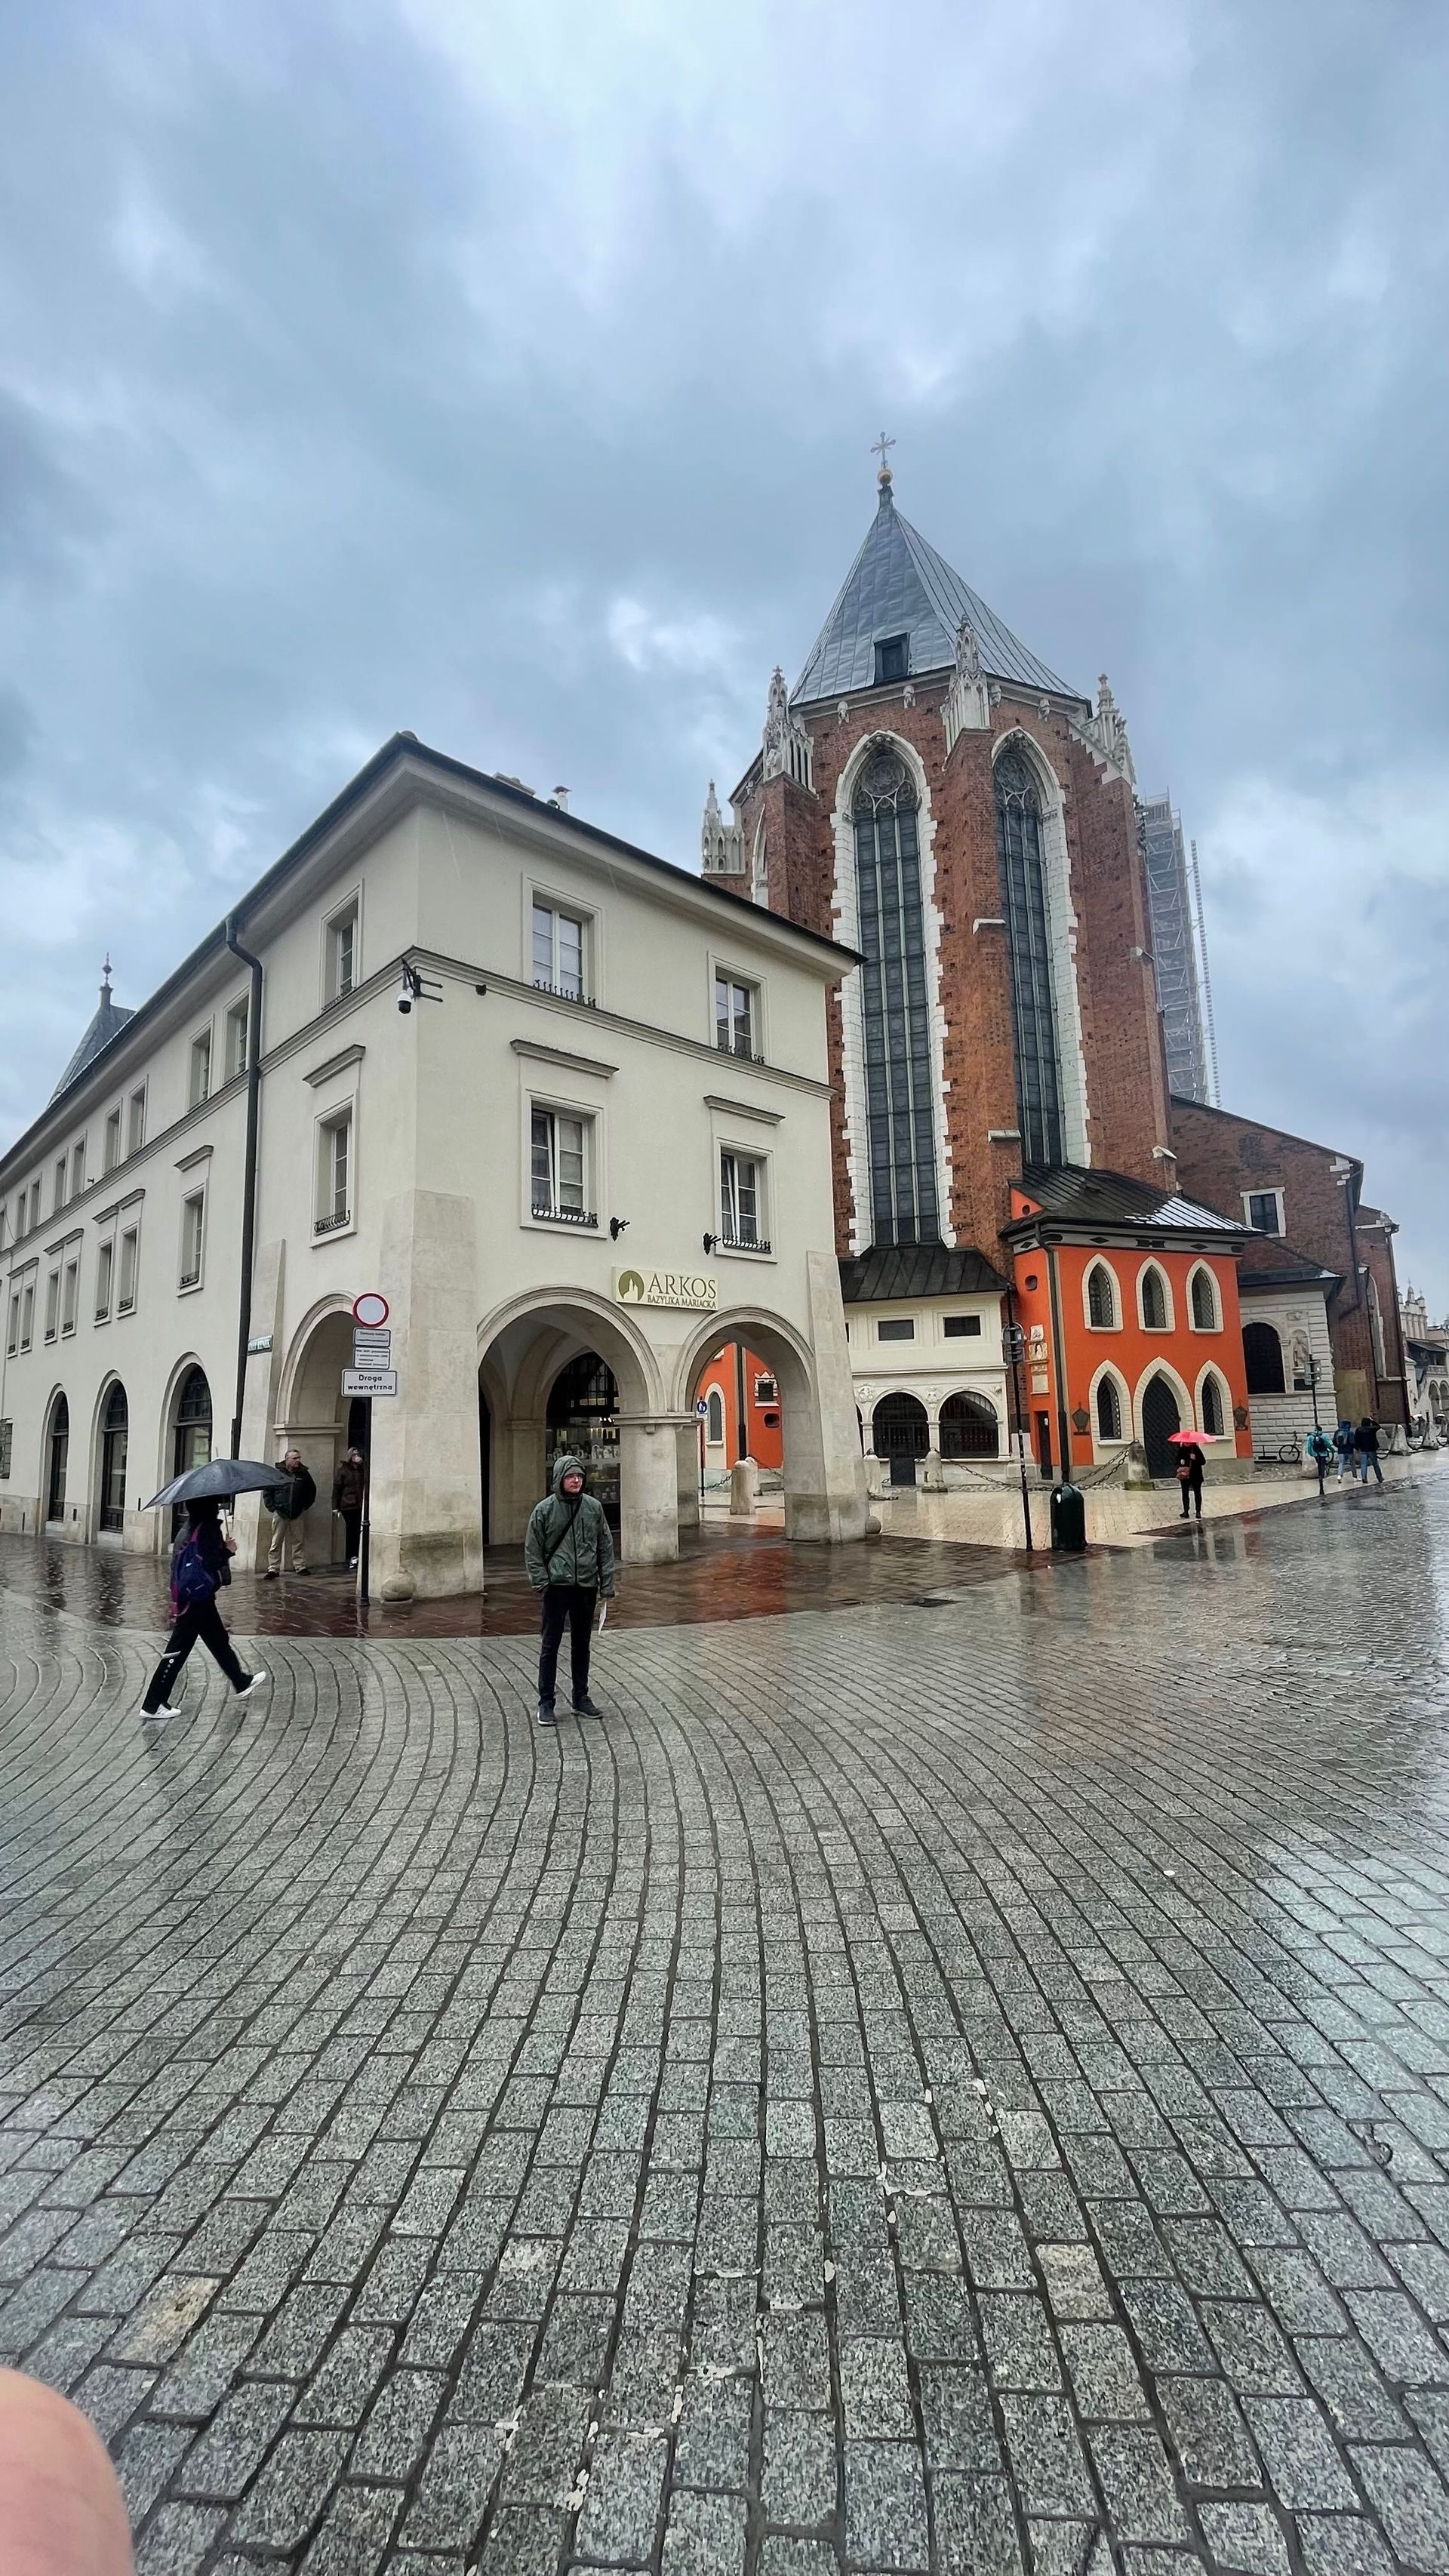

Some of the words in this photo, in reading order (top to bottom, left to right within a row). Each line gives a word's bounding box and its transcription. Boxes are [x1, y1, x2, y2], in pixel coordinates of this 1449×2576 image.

[648, 1273, 716, 1299] ARKOS
[648, 1294, 679, 1306] BAZYLIKA
[681, 1299, 716, 1309] MARIACKA
[358, 1374, 382, 1383] Droga
